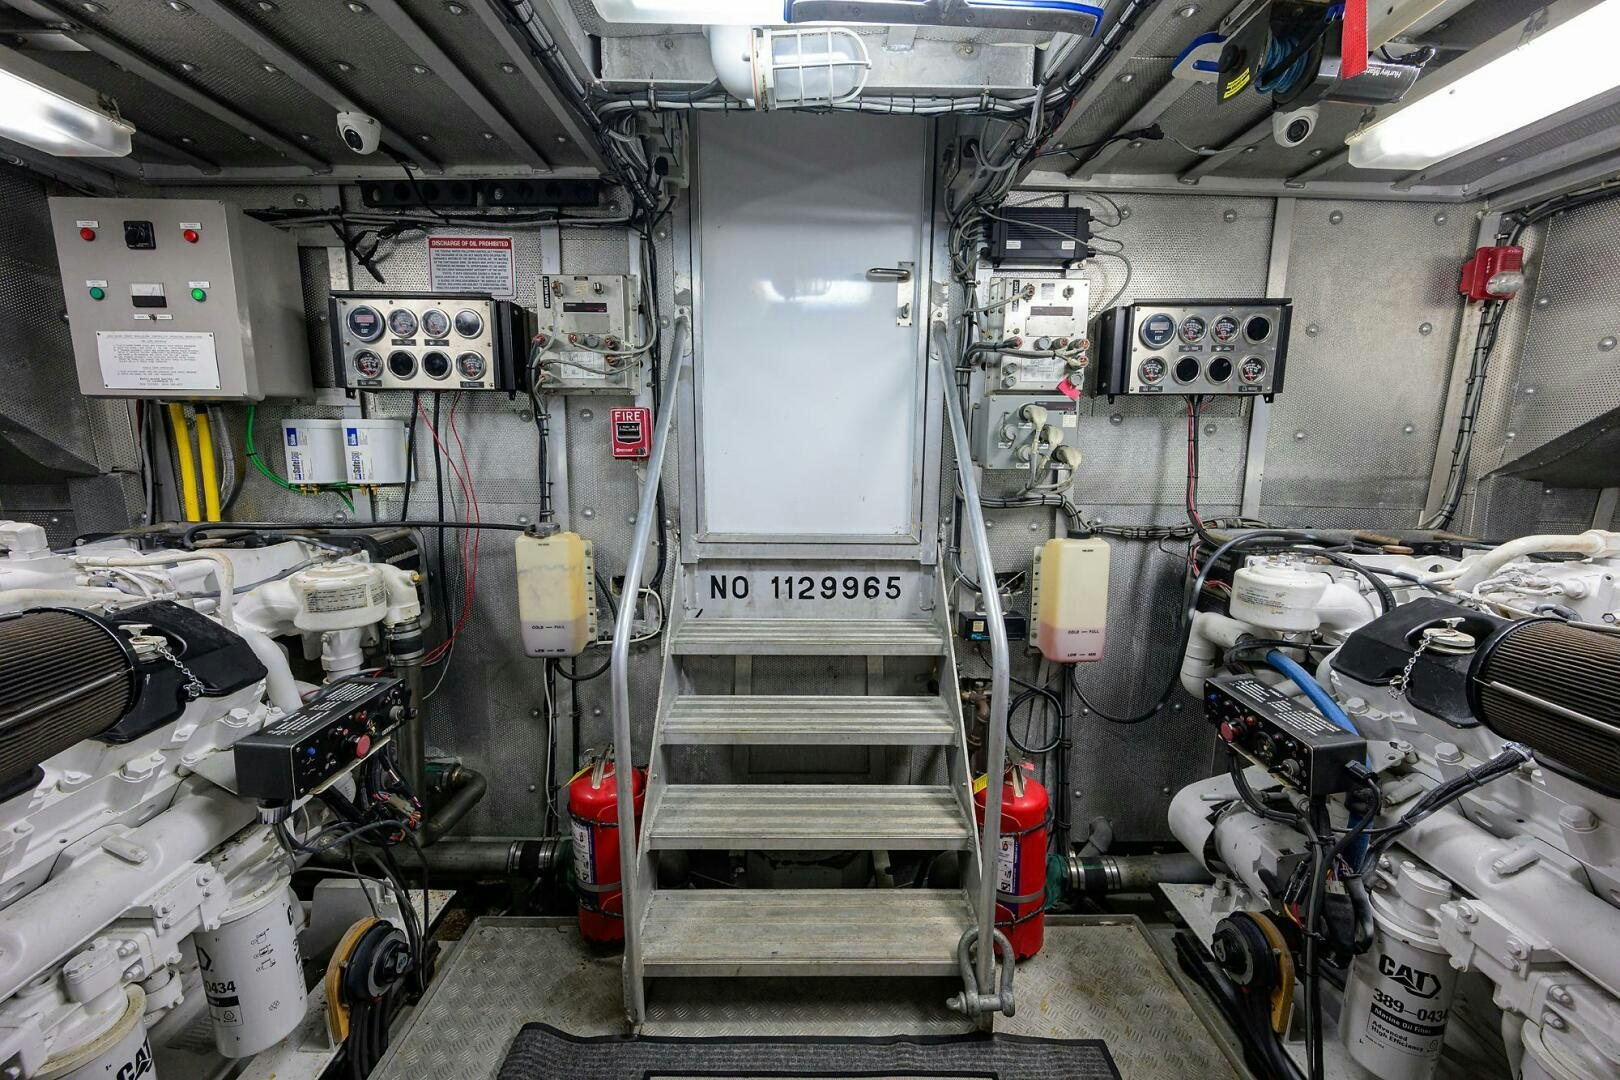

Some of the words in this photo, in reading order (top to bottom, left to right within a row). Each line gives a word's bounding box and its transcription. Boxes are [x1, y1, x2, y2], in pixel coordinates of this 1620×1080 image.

[1380, 68, 1402, 78] Hurley
[615, 411, 640, 421] FIRE
[710, 575, 749, 600] NO
[771, 575, 901, 600] 1129965
[1379, 953, 1434, 993] CAT
[1374, 1008, 1401, 1026] Marine
[1402, 1021, 1413, 1030] Oil
[1371, 1025, 1388, 1038] High
[1388, 1036, 1424, 1052] Efficiency
[1372, 1020, 1408, 1042] Advanced
